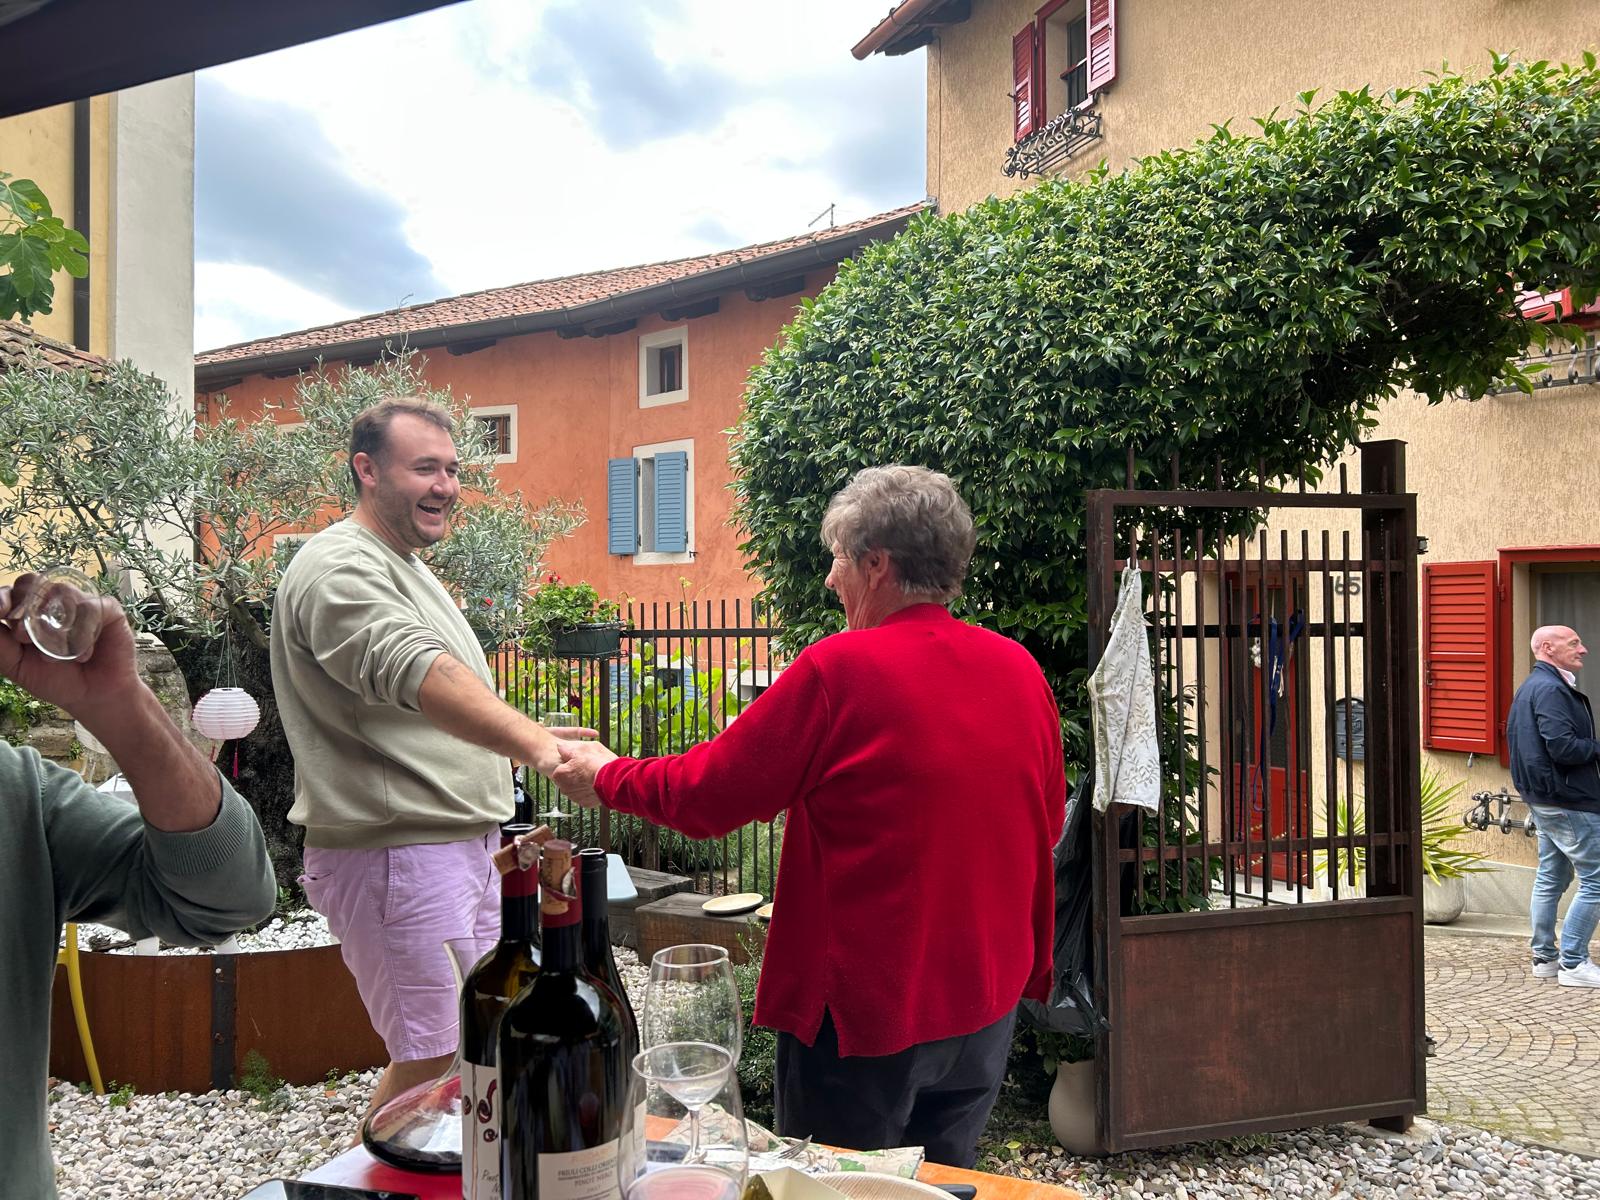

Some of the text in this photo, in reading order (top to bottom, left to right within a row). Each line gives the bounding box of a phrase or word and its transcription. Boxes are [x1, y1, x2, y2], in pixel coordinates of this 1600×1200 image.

[1335, 576, 1361, 595] 65
[558, 1168, 578, 1177] FRIULI
[579, 1164, 597, 1174] COLLI
[574, 1177, 595, 1187] PINOT
[597, 1171, 613, 1182] NERO
